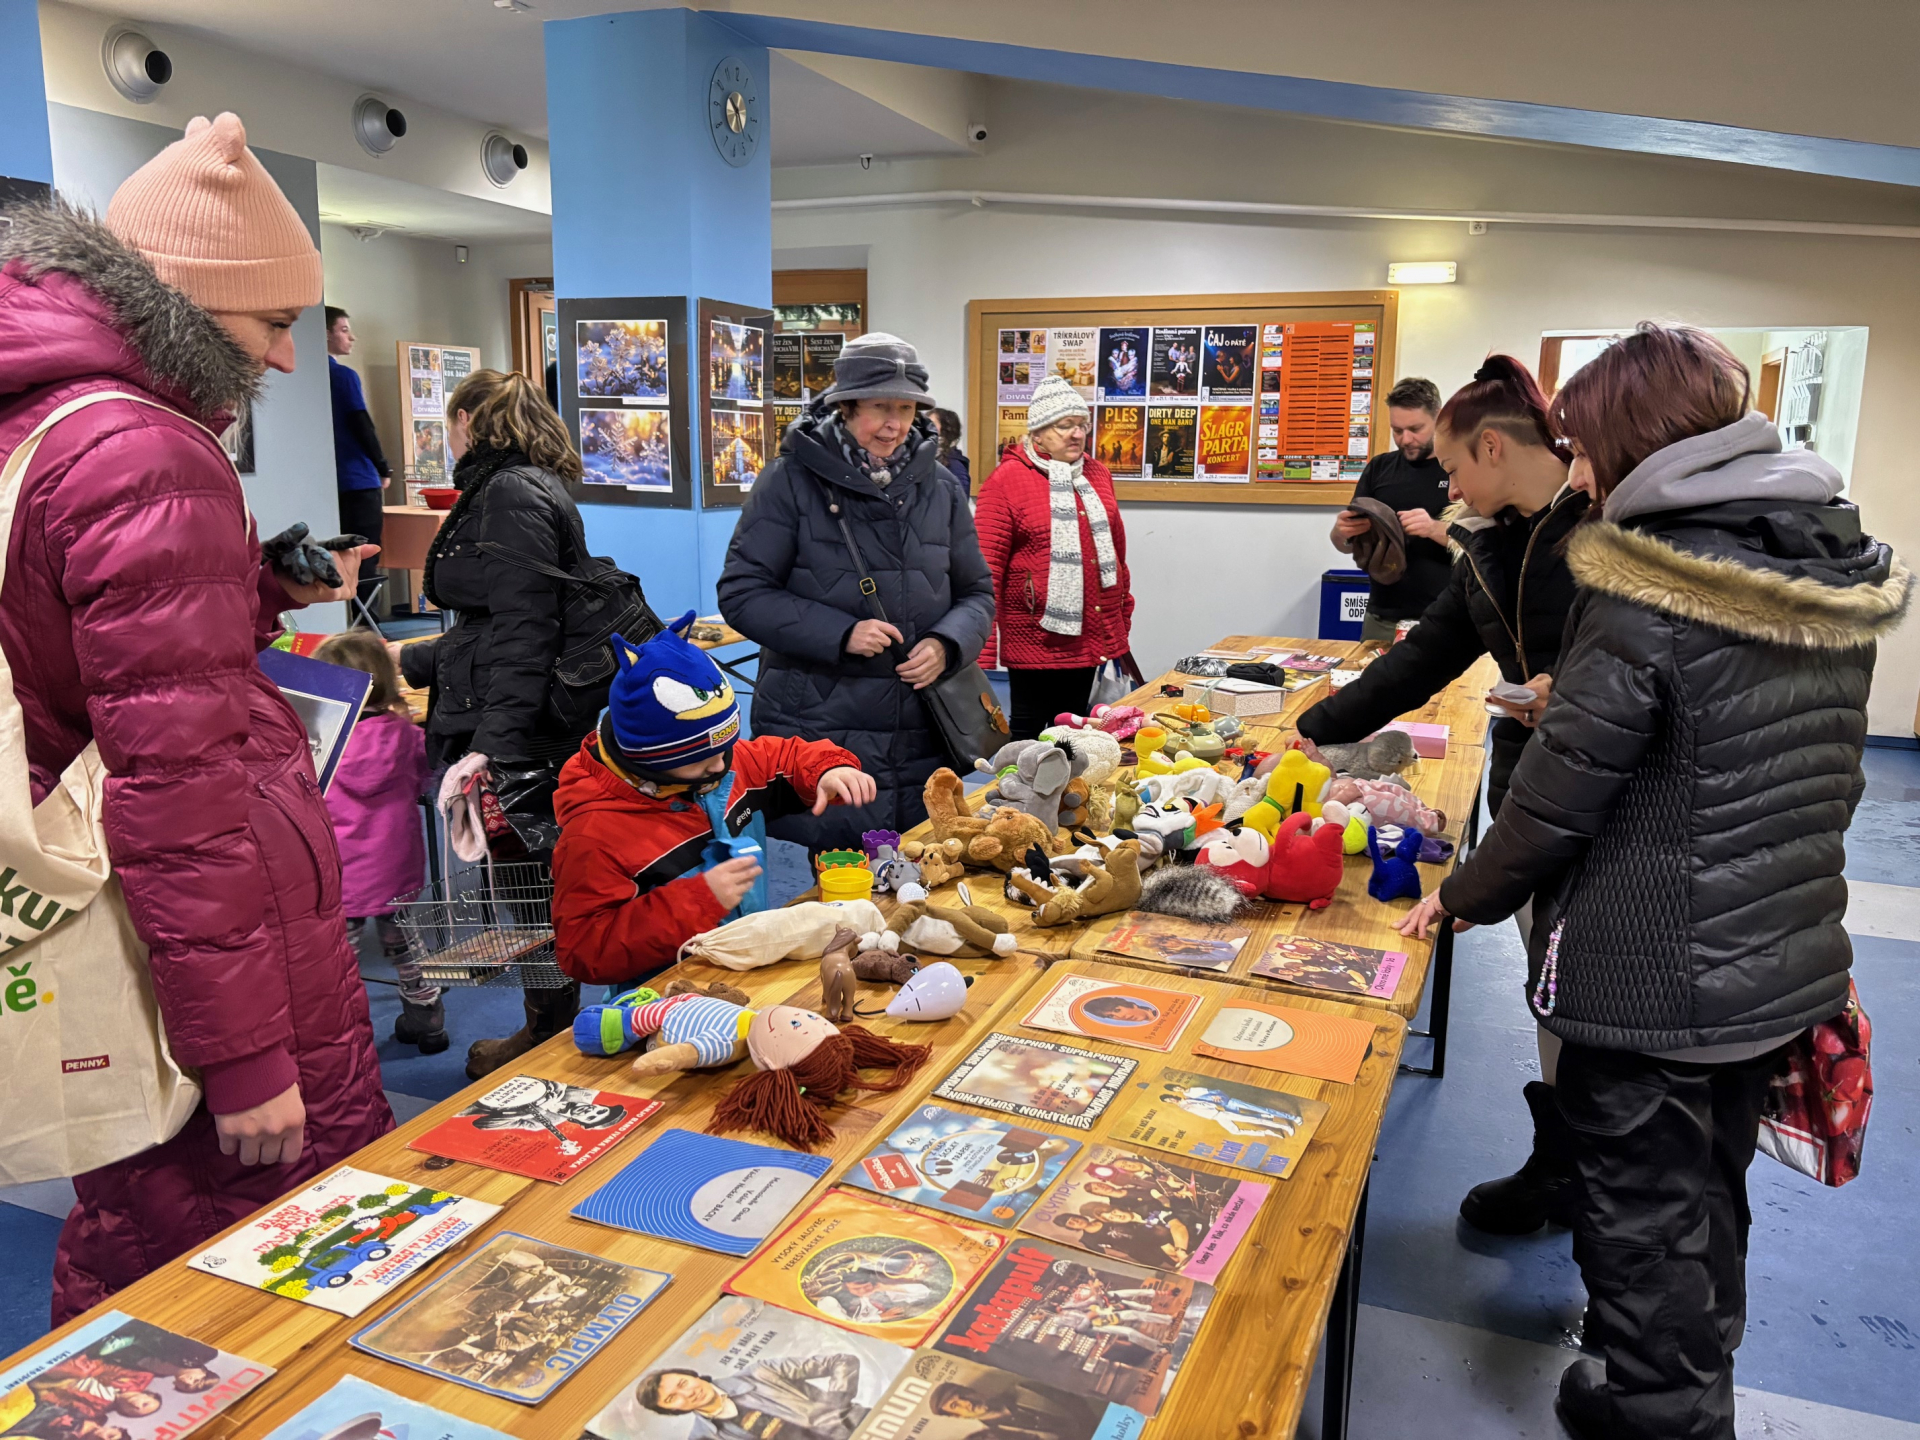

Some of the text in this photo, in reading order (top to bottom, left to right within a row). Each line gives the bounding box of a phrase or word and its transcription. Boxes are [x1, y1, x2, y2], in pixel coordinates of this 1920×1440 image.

[1053, 331, 1095, 339] TŘÍKRÁLOVÝ
[1208, 330, 1224, 346] ČAJ
[1002, 409, 1028, 420] Fami
[1105, 408, 1138, 422] PLES
[1149, 408, 1172, 418] DIRTY
[1175, 408, 1196, 418] DEEP
[1201, 419, 1244, 440] ŠLÁGR
[1202, 436, 1249, 455] PARTA
[1207, 454, 1240, 464] KONCERT
[1344, 596, 1368, 607] SMÍŠE
[1348, 609, 1364, 618] ODP
[988, 1032, 1125, 1064] SUPRAPHON SUPRAPHON
[633, 1100, 660, 1117] BANJO
[615, 1116, 639, 1131] BAND
[595, 1130, 622, 1146] IVANA
[567, 1146, 603, 1169] MLÁDKA
[1030, 1178, 1082, 1223] OLYMPIC
[252, 1203, 302, 1230] BANJO
[272, 1209, 312, 1230] BAND
[820, 1218, 843, 1233] POLE
[252, 1226, 304, 1254] IVANA
[769, 1216, 827, 1263] VYSOKÝ JALOVEC
[351, 1215, 462, 1288] V MOTELU V MOTOLE
[938, 1243, 1070, 1358] katapult
[538, 1292, 645, 1373] OLYMPIC
